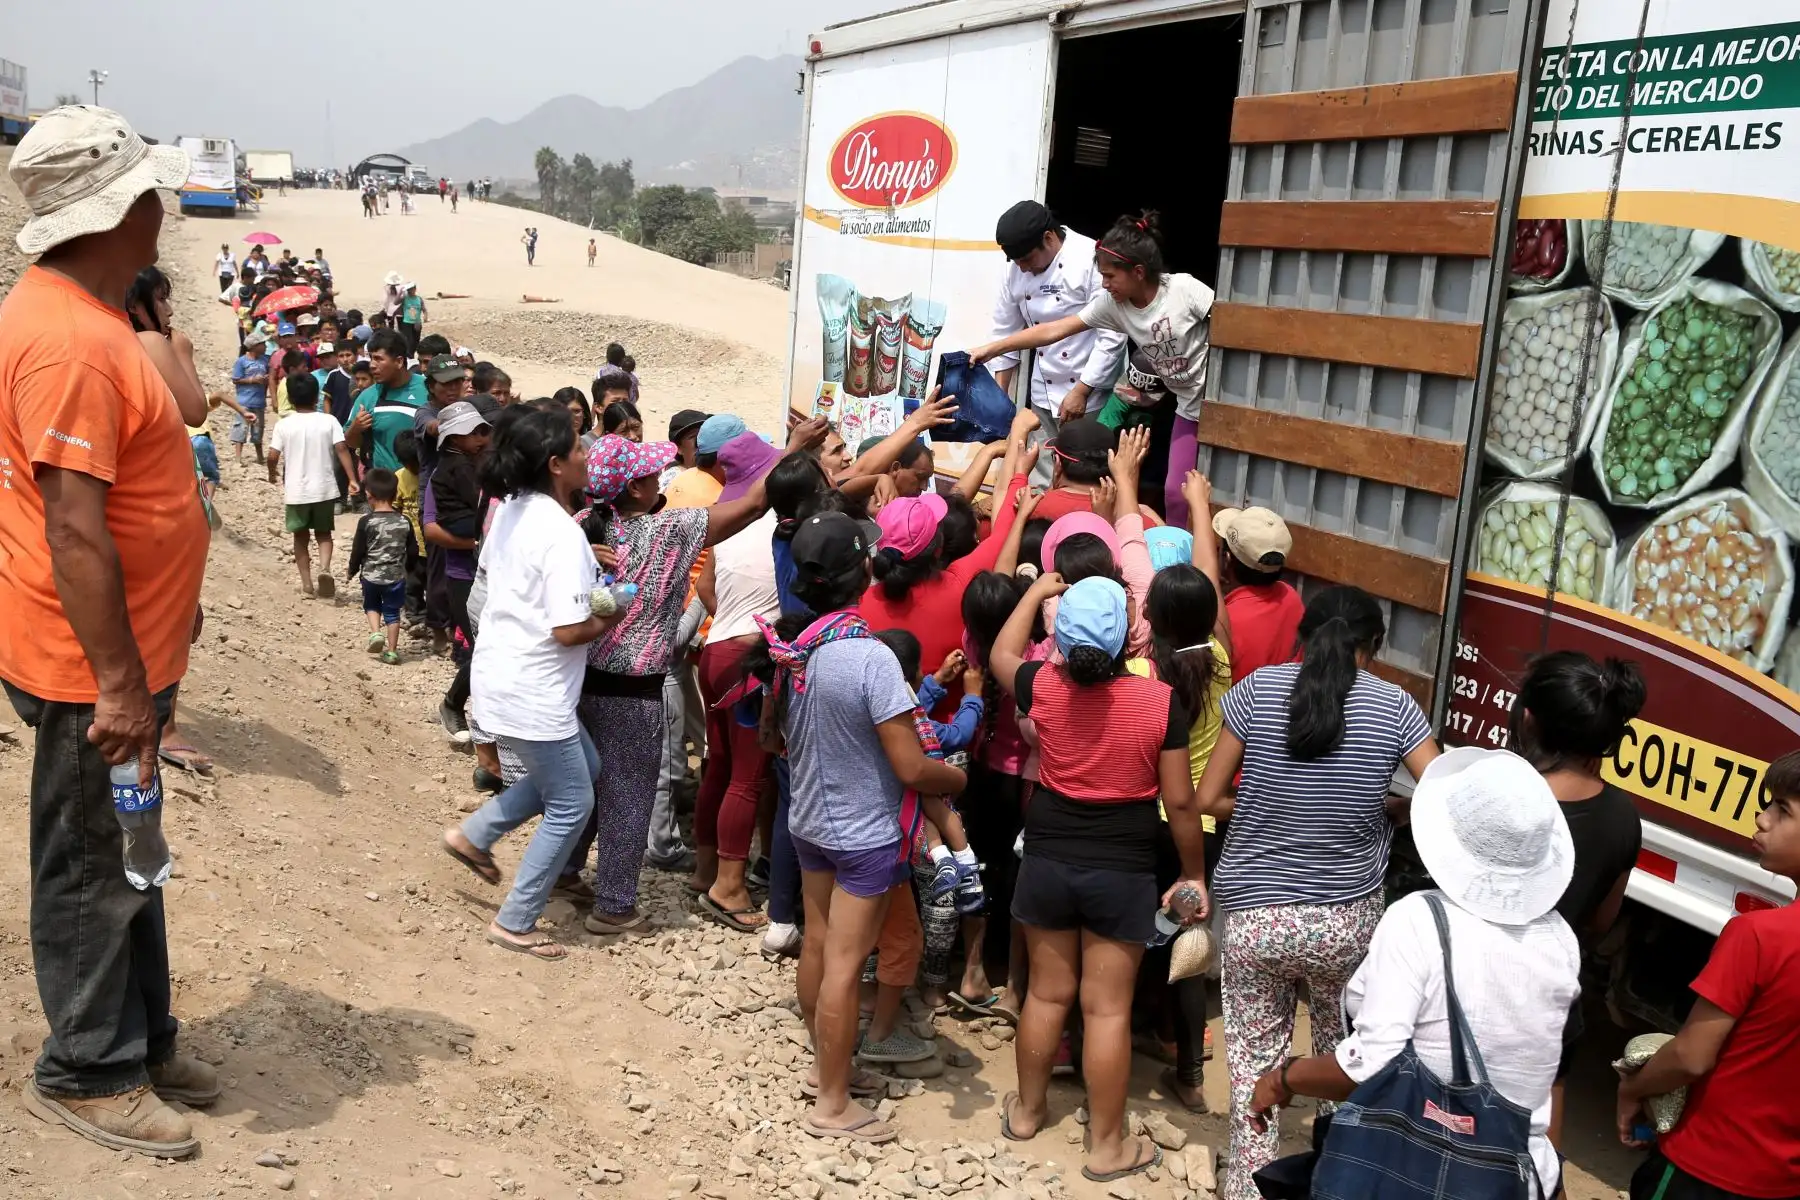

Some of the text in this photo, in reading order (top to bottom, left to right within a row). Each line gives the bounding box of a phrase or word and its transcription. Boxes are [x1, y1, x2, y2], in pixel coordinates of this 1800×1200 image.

[1612, 46, 1669, 75] CON
[1670, 44, 1704, 71] LA
[1576, 84, 1621, 110] DEL
[1631, 74, 1763, 106] MERCADO
[1627, 121, 1783, 154] CEREALES
[841, 130, 938, 208] Diony's
[840, 216, 931, 235] tu socio en alimentos
[56, 431, 92, 450] GENERAL
